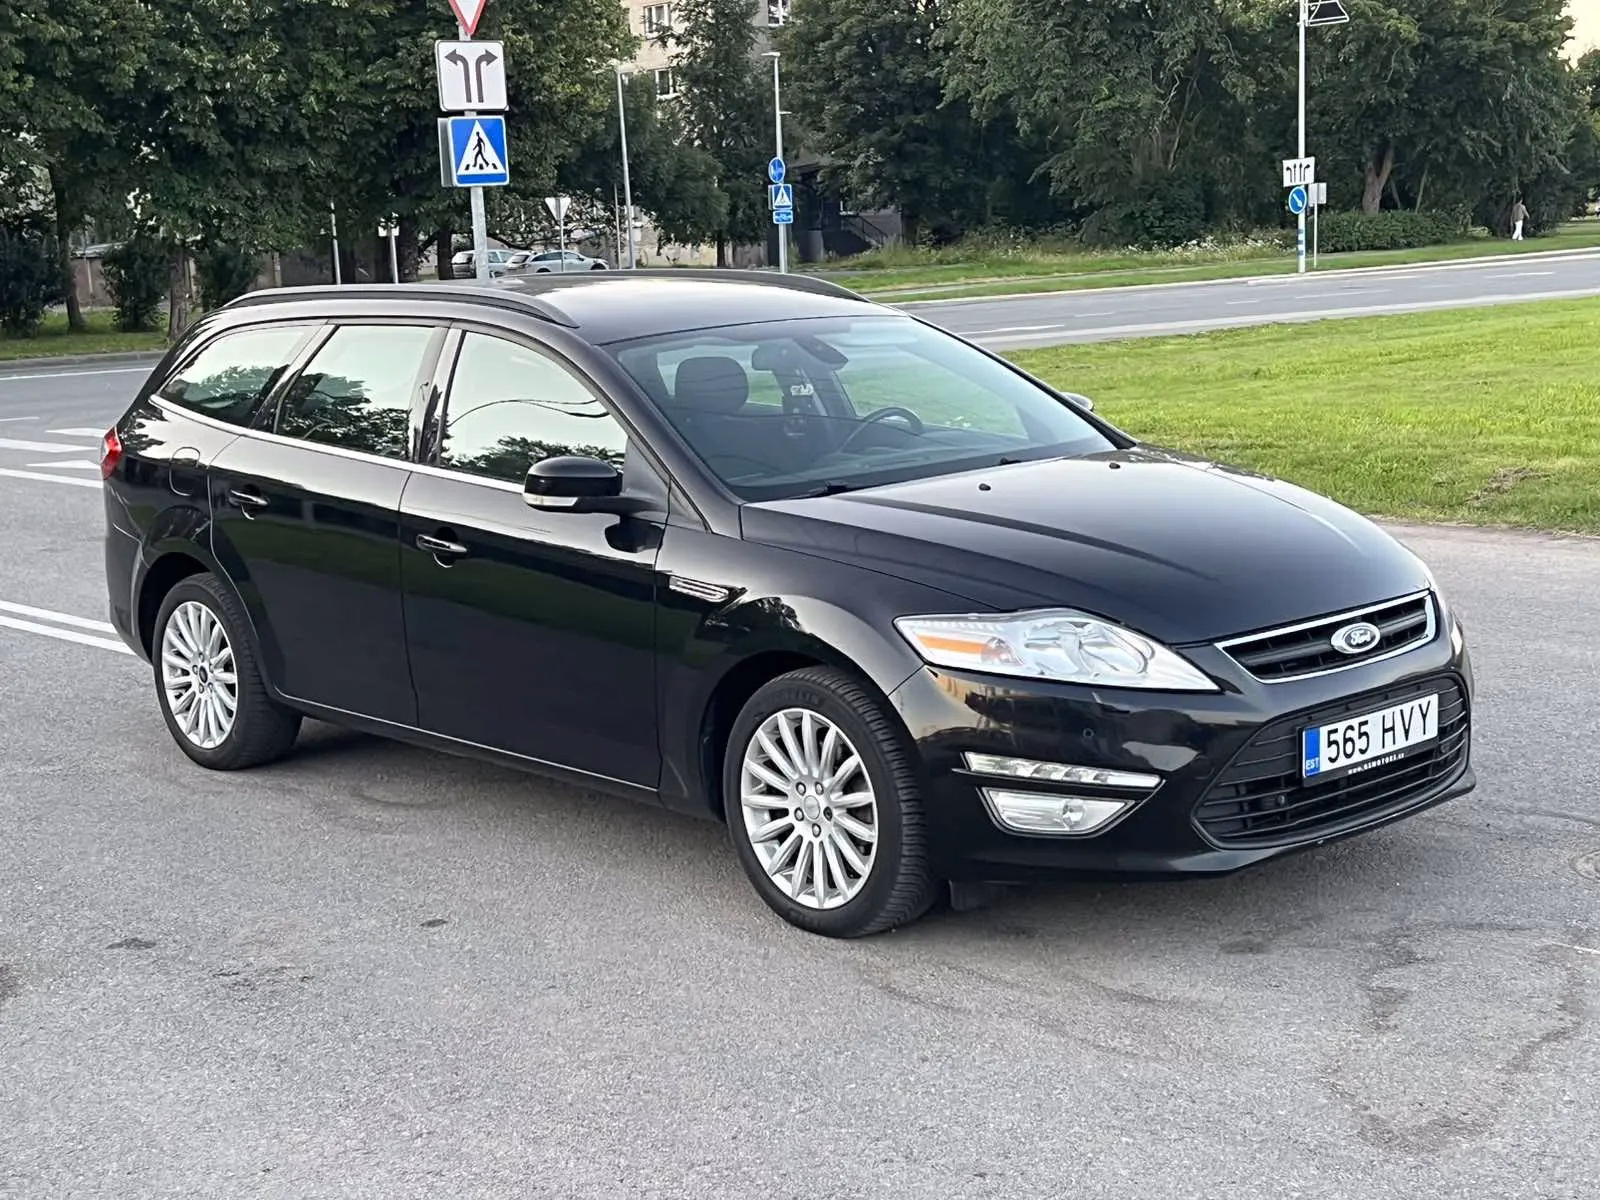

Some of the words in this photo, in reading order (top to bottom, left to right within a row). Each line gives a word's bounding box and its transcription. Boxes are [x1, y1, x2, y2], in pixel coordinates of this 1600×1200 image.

[1327, 720, 1370, 763] 565
[1382, 700, 1431, 749] HVY
[1305, 757, 1319, 770] EST
